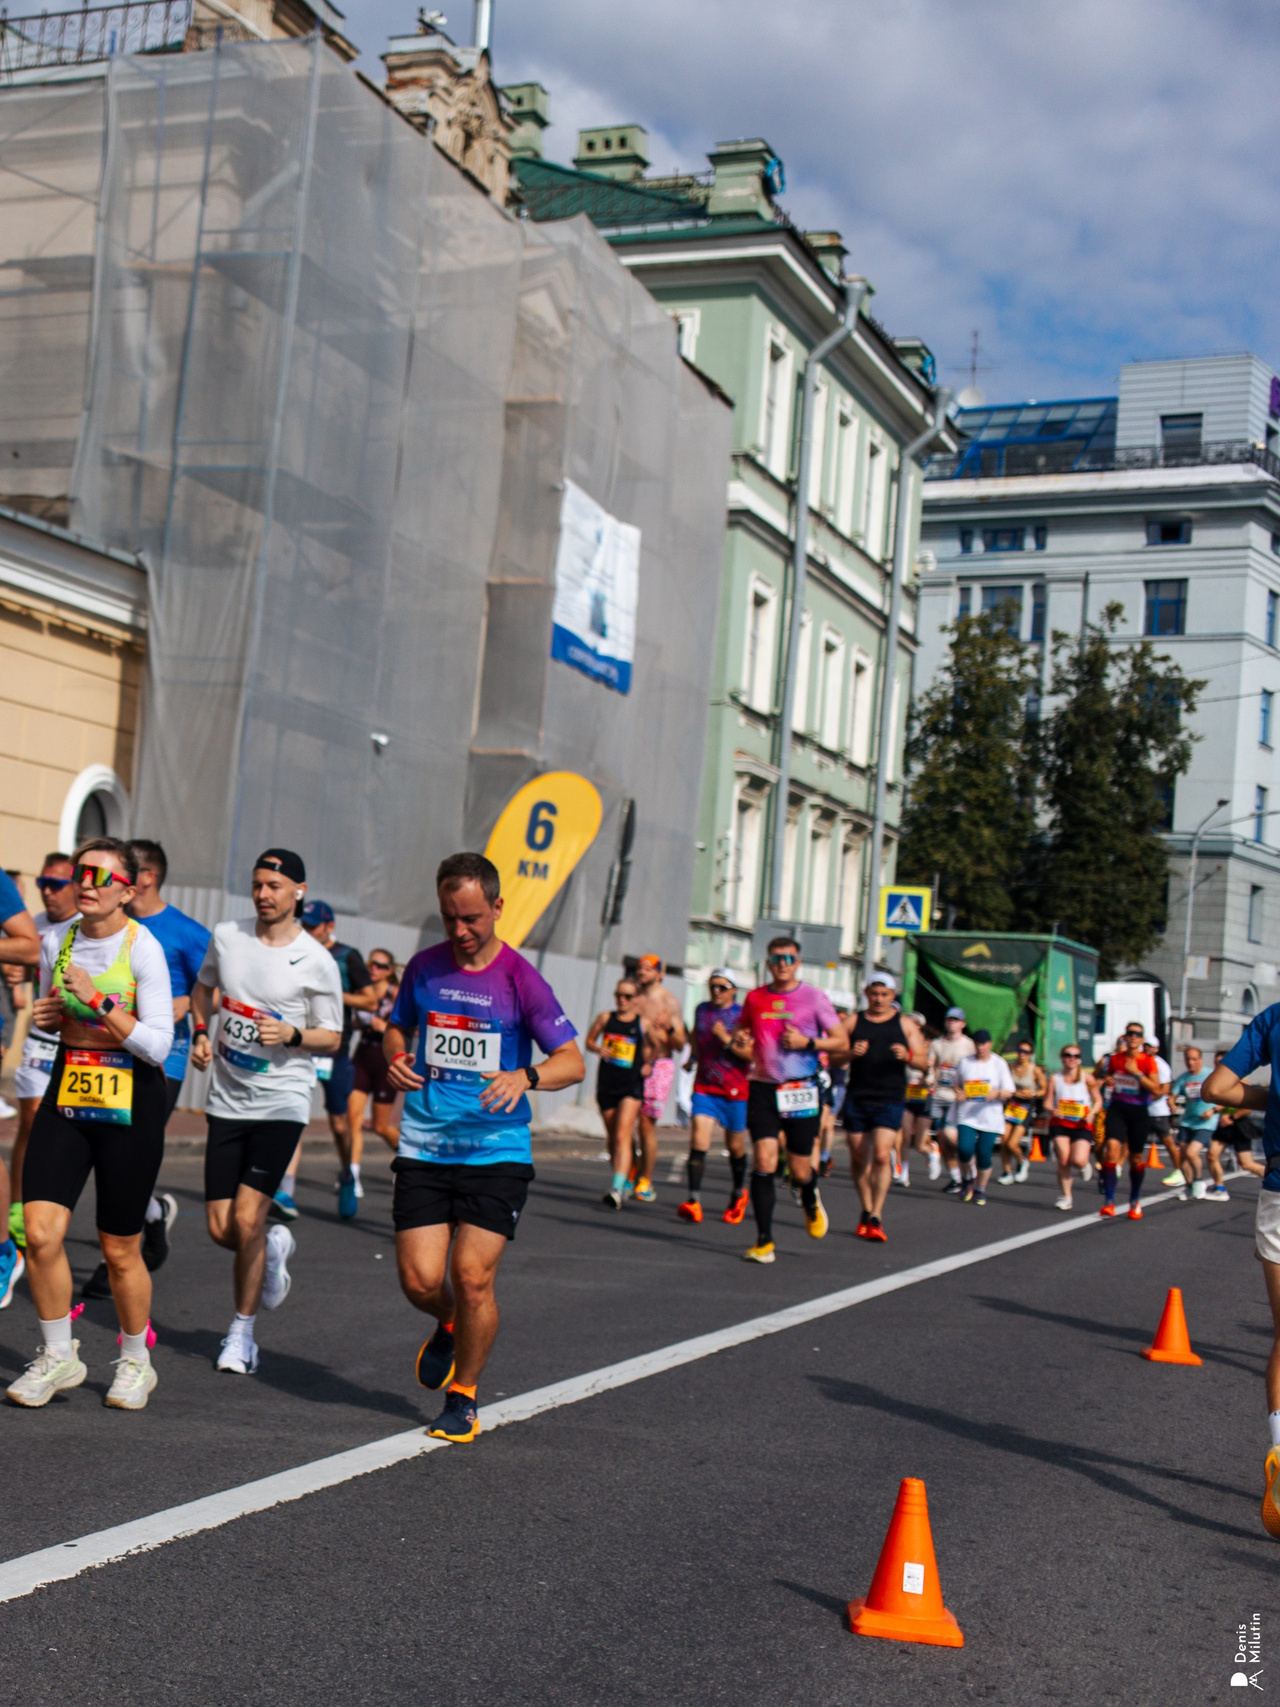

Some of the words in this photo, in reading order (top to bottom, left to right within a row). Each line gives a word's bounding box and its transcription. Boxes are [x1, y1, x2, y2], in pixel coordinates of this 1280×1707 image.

[526, 801, 557, 852] 6
[518, 859, 549, 881] КМ
[224, 1017, 264, 1047] 433
[434, 1033, 487, 1060] 2001
[430, 1066, 439, 1079] D
[444, 1057, 477, 1067] АЛЕКСЕЙ
[67, 1071, 119, 1096] 2511
[64, 1107, 74, 1118] D
